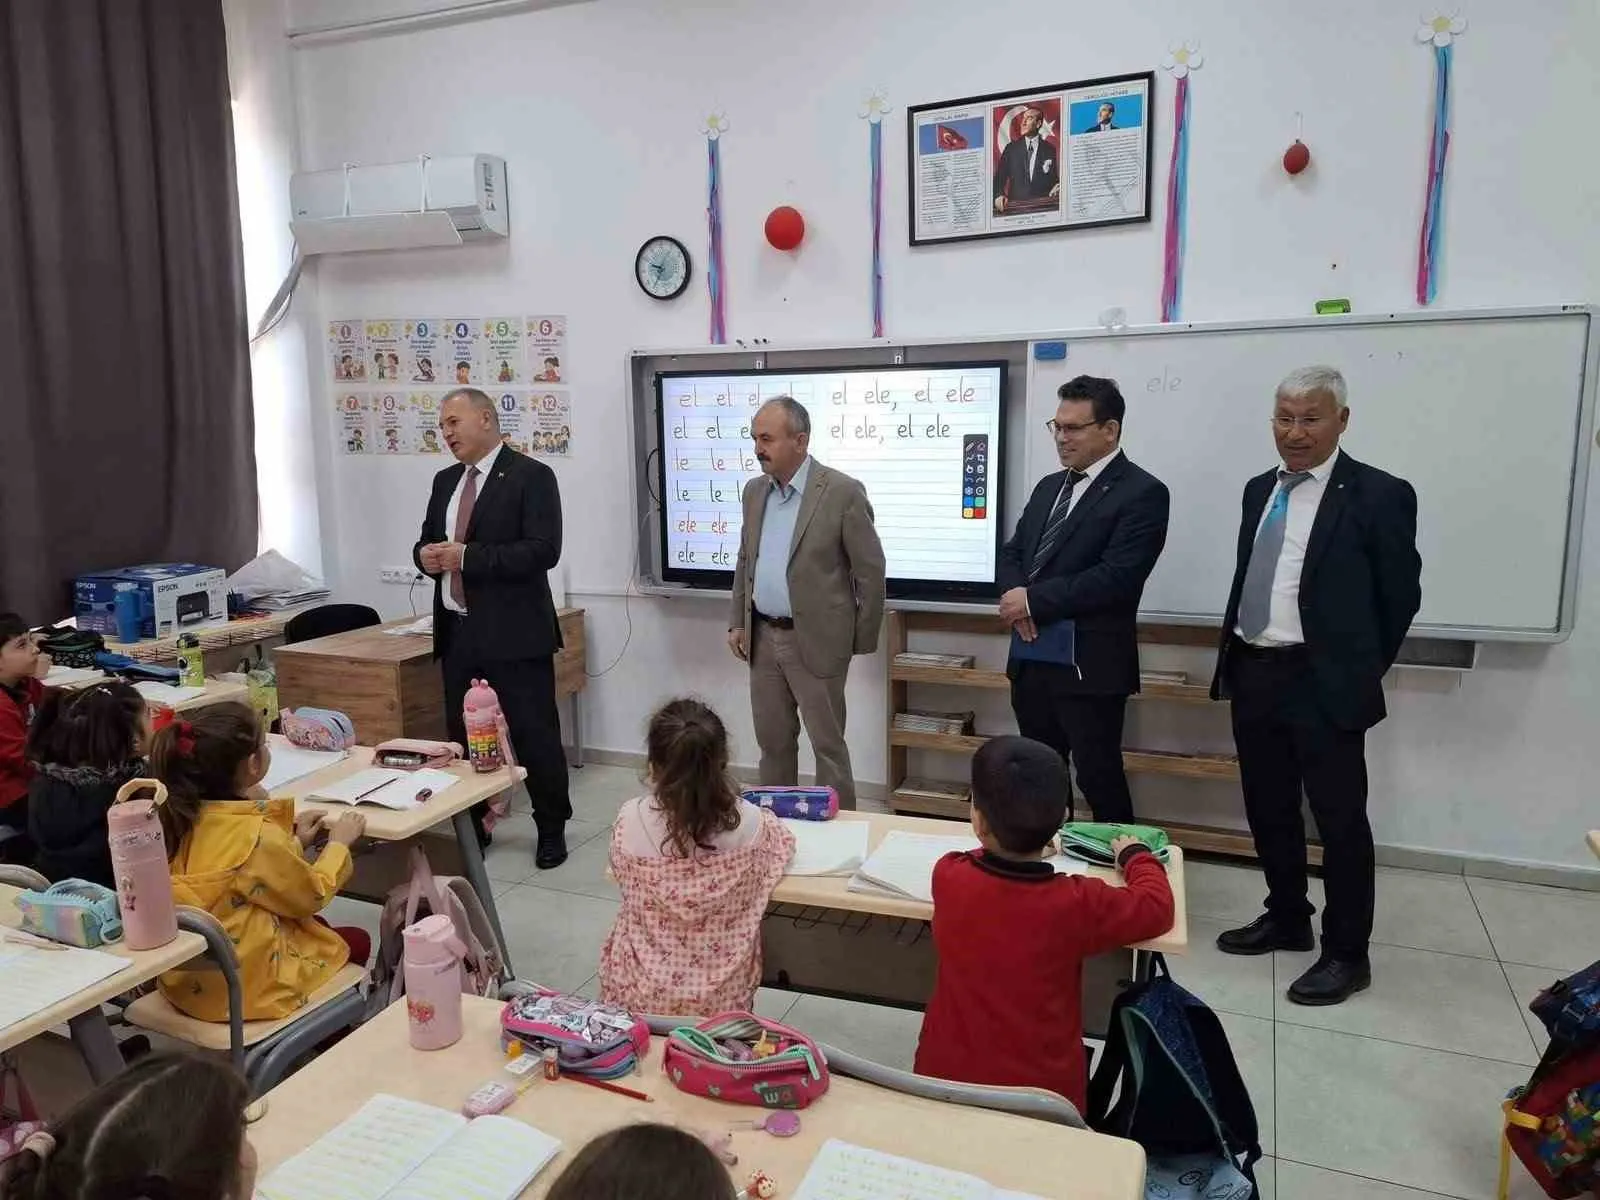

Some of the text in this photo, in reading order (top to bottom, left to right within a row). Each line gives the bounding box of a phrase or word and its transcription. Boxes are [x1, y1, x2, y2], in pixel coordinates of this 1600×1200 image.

[832, 380, 848, 405] el
[914, 377, 933, 403] el
[946, 376, 975, 404] ele
[1146, 364, 1182, 393] ele
[680, 383, 699, 407] el
[717, 383, 732, 407] el
[748, 383, 760, 408] el
[673, 416, 688, 439] el
[706, 416, 722, 439] el
[831, 414, 845, 439] el
[897, 413, 913, 438] el
[926, 412, 950, 438] ele
[676, 448, 755, 471] le le le
[677, 480, 690, 502] le
[710, 480, 726, 502] le
[678, 511, 728, 534] ele ele
[678, 541, 729, 565] ele ele
